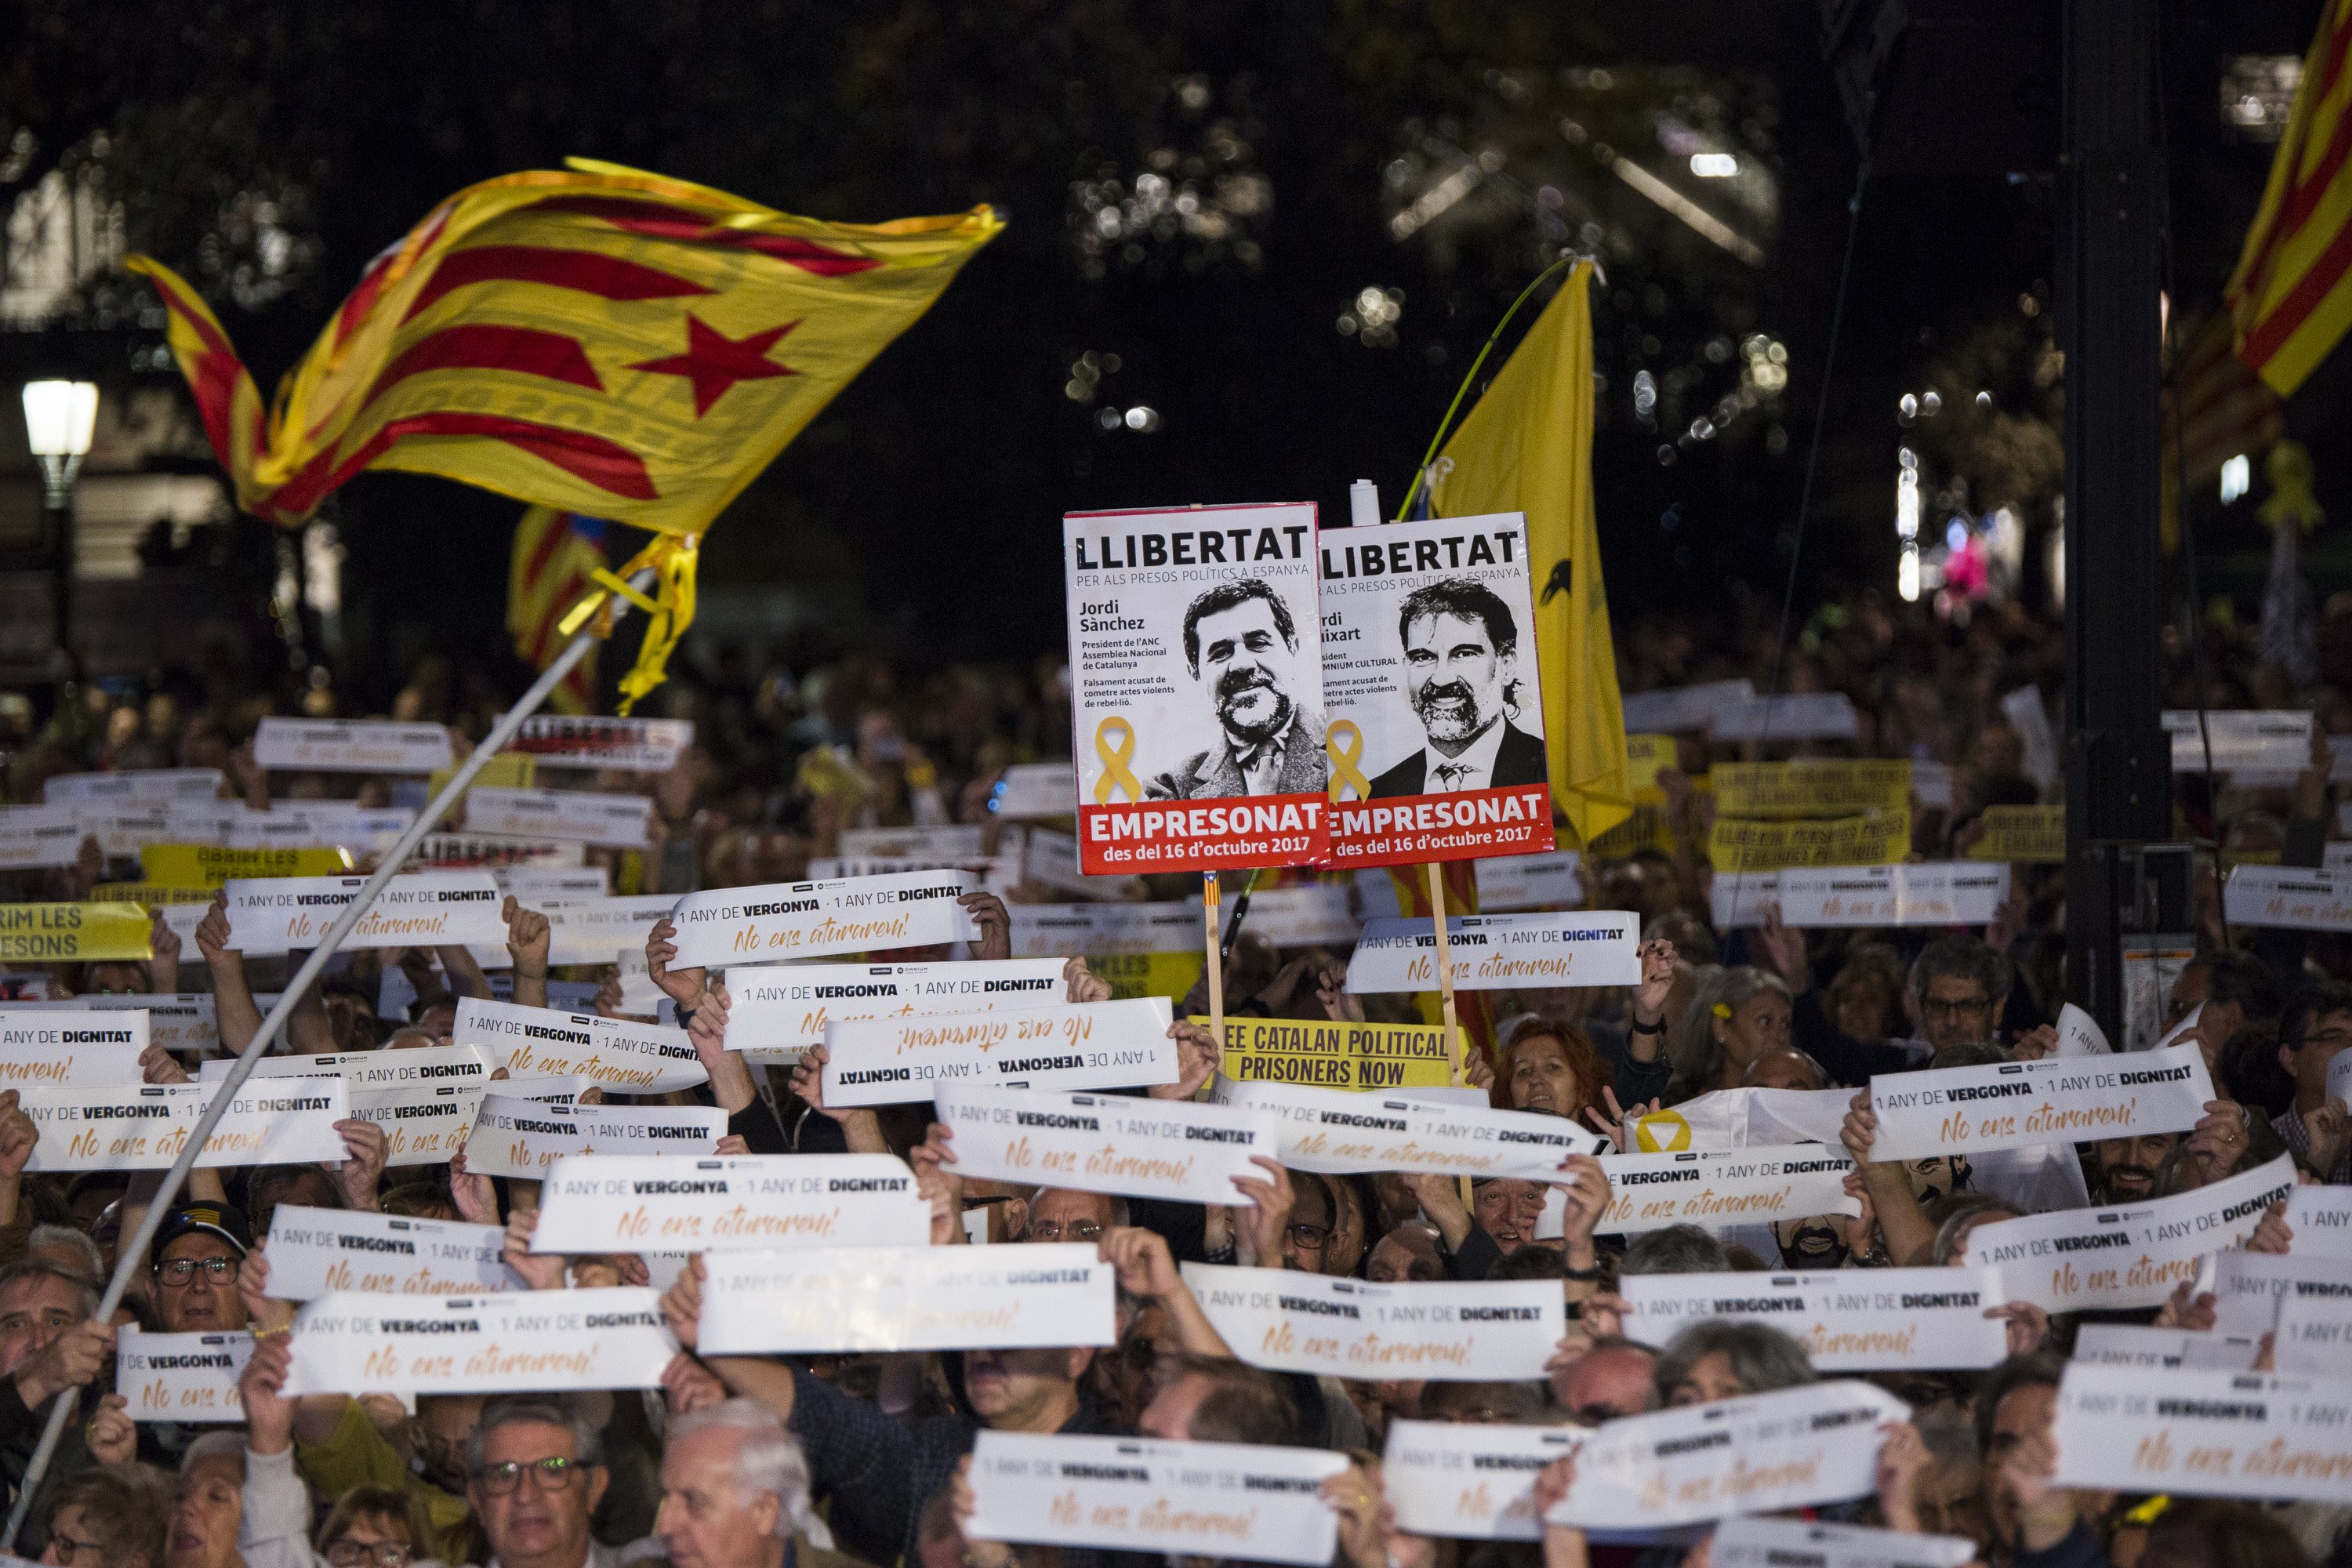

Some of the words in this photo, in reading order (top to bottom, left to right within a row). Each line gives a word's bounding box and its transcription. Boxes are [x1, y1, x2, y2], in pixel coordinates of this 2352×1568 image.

[1076, 525, 1308, 569] LLIBERTAT
[1321, 532, 1518, 579] LIBERTAT
[1077, 575, 1099, 586] PER
[1104, 574, 1125, 585] ALS
[1131, 572, 1178, 583] PRESOS
[1182, 567, 1236, 582] POLÍTICS
[1241, 568, 1248, 578] A
[1254, 564, 1308, 578] ESPANYA
[1327, 585, 1347, 595] ALS
[1352, 579, 1396, 593] PRESOS
[1467, 568, 1521, 581] ESPANYA
[1080, 600, 1119, 615] Jordi
[1080, 618, 1145, 632] Sànchez
[1322, 612, 1342, 626] rdi
[1082, 640, 1122, 648] President
[1082, 650, 1127, 659] Assemblea
[1130, 648, 1167, 657] Nacional
[1095, 660, 1137, 670] Catalunya
[1322, 652, 1346, 661] sident
[1323, 662, 1352, 670] MNIUM
[1356, 658, 1398, 668] CULTURAL
[1083, 678, 1125, 687] Falsament
[1142, 686, 1174, 695] violents
[1367, 684, 1397, 693] violents
[1091, 803, 1322, 840] EMPRESONAT
[1104, 847, 1131, 862] des
[1136, 845, 1160, 860] del
[1165, 844, 1184, 858] 16
[1272, 837, 1310, 852] 2017
[1337, 843, 1363, 857] des
[1367, 839, 1390, 854] del
[1395, 837, 1413, 852] 16
[1496, 826, 1532, 843] 2017
[680, 913, 684, 924] 1
[690, 908, 717, 923] ANY
[722, 906, 739, 919] DE
[743, 899, 820, 917] VERGONYA
[834, 897, 840, 908] 1
[846, 894, 873, 908] ANY
[877, 891, 895, 904] DE
[898, 886, 963, 902] DIGNITAT
[41, 907, 82, 929] LES
[734, 924, 760, 953] No
[769, 929, 800, 948] ens
[810, 913, 909, 945] aturarem!
[1367, 937, 1392, 949] ANY
[1396, 936, 1413, 948] DE
[1502, 933, 1507, 943] 1
[1512, 931, 1538, 942] ANY
[1542, 931, 1559, 942] DE
[1563, 928, 1624, 941] DIGNITAT
[1408, 955, 1432, 981] No
[1479, 953, 1572, 978] aturarem!
[745, 989, 750, 1000] 1
[757, 987, 786, 1000] ANY
[792, 986, 811, 1000] DE
[815, 984, 898, 998] VERGONYA
[914, 983, 920, 995] 1
[926, 982, 956, 995] ANY
[960, 980, 980, 993] DE
[984, 978, 1054, 992] DIGNITAT
[4, 1031, 34, 1043] ANY
[39, 1031, 58, 1043] DE
[63, 1031, 132, 1043] DIGNITAT
[469, 1017, 474, 1028] 1
[477, 1018, 503, 1031] ANY
[505, 1022, 521, 1035] DE
[524, 1025, 591, 1045] VERGONYA
[603, 1036, 609, 1047] 1
[612, 1039, 638, 1052] ANY
[641, 1042, 656, 1055] DE
[896, 1021, 1007, 1055] aturarem!
[1018, 1019, 1053, 1040] ens
[1063, 1014, 1093, 1047] No
[1254, 1025, 1339, 1053] CATALAN
[1348, 1030, 1448, 1056] POLITICAL
[507, 1045, 533, 1073] No
[538, 1054, 568, 1076] ens
[572, 1055, 662, 1087] aturarem!
[998, 1055, 1084, 1073] VERGONYA
[1088, 1053, 1108, 1066] DE
[1113, 1050, 1143, 1065] ANY
[1150, 1050, 1156, 1062] 1
[839, 1068, 909, 1084] DIGNITAT
[914, 1065, 934, 1080] DE
[939, 1063, 969, 1077] ANY
[976, 1062, 982, 1074] 1
[1240, 1058, 1351, 1083] PRISONERS
[1359, 1062, 1406, 1085] NOW
[1876, 1097, 1883, 1110] 1
[1889, 1092, 1918, 1109] ANY
[1923, 1090, 1943, 1105] DE
[1947, 1082, 2032, 1102] VERGONYA
[2049, 1080, 2055, 1092] 1
[2061, 1076, 2091, 1091] ANY
[2096, 1074, 2117, 1088] DE
[2120, 1065, 2192, 1086] DIGNITAT
[1941, 1110, 1970, 1144] No
[1980, 1115, 2016, 1136] ens
[2025, 1098, 2136, 1133] aturarem!
[1621, 1168, 1700, 1185] VERGONYA
[1716, 1167, 1721, 1178] 1
[1726, 1165, 1756, 1178] ANY
[1760, 1163, 1780, 1176] DE
[1783, 1160, 1853, 1174] DIGNITAT
[565, 1181, 600, 1195] ANY
[605, 1180, 626, 1195] DE
[633, 1181, 728, 1194] VERGONYA
[760, 1179, 796, 1192] ANY
[801, 1178, 822, 1192] DE
[829, 1178, 909, 1192] DIGNITAT
[1604, 1194, 1633, 1222] No
[1641, 1200, 1673, 1218] ens
[1683, 1185, 1792, 1217] aturarem!
[616, 1206, 650, 1238] No
